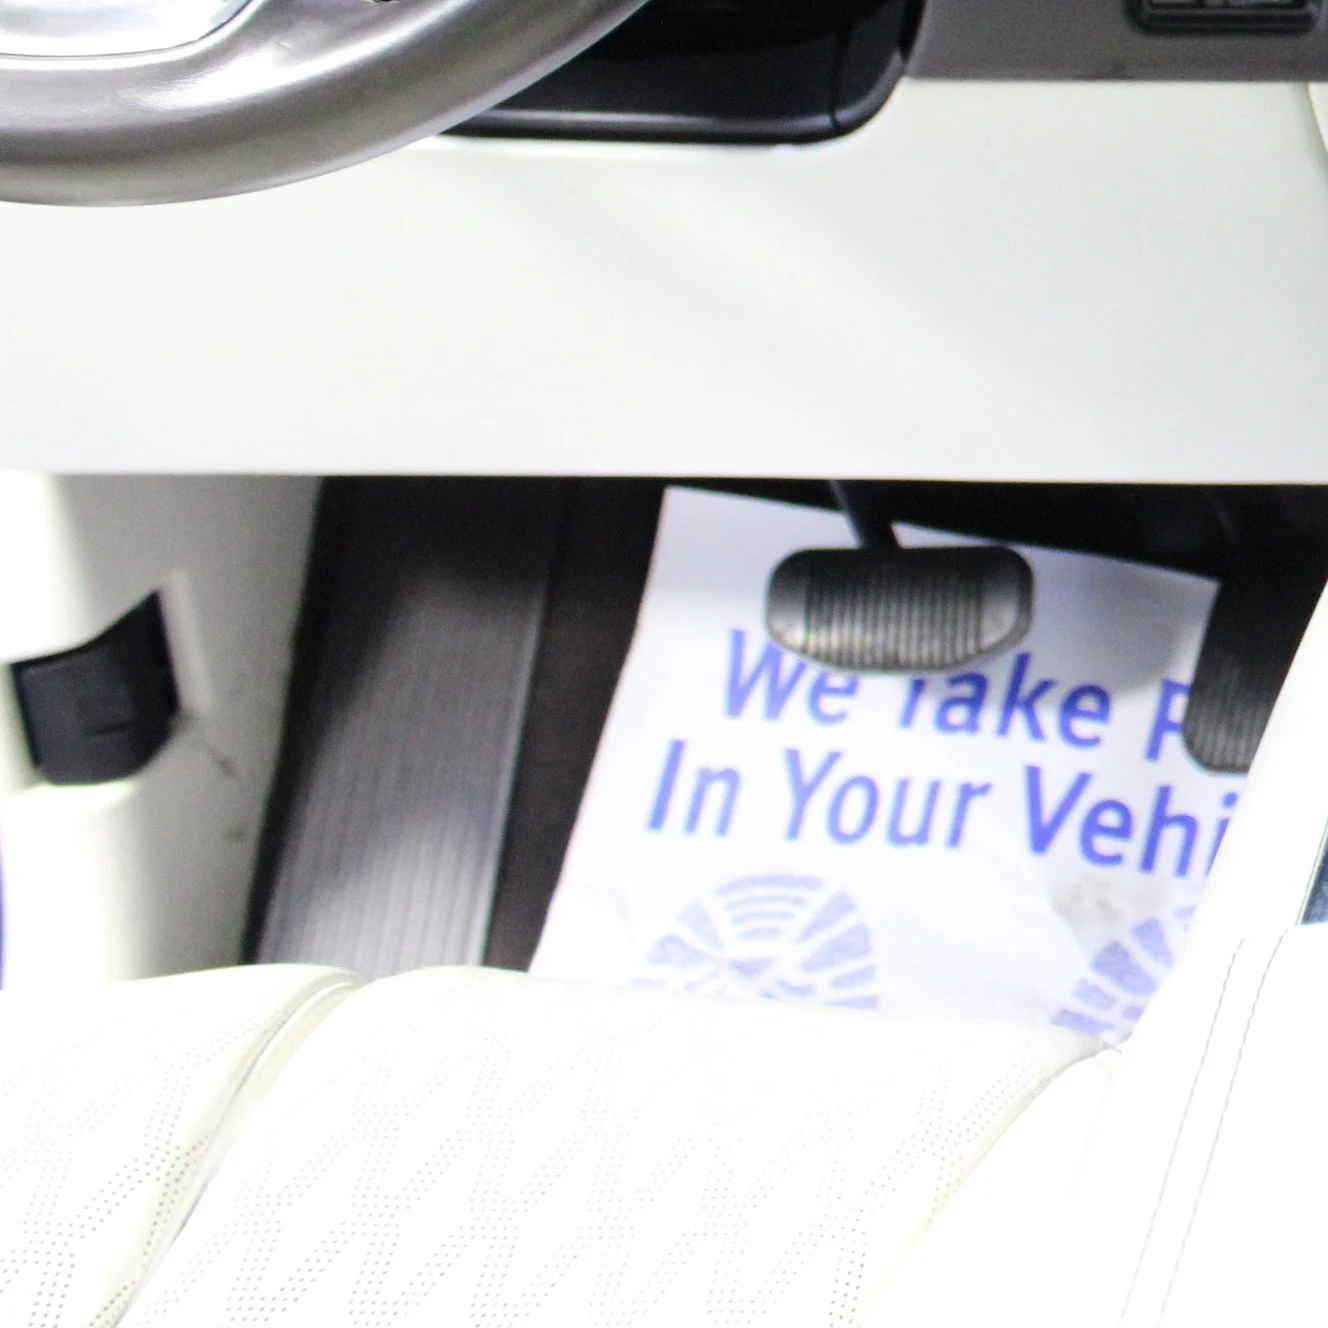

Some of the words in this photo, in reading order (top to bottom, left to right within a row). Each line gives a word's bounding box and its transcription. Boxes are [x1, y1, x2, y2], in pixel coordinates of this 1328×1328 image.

[722, 629, 860, 724] We
[645, 739, 741, 838] In
[783, 748, 993, 850] Your
